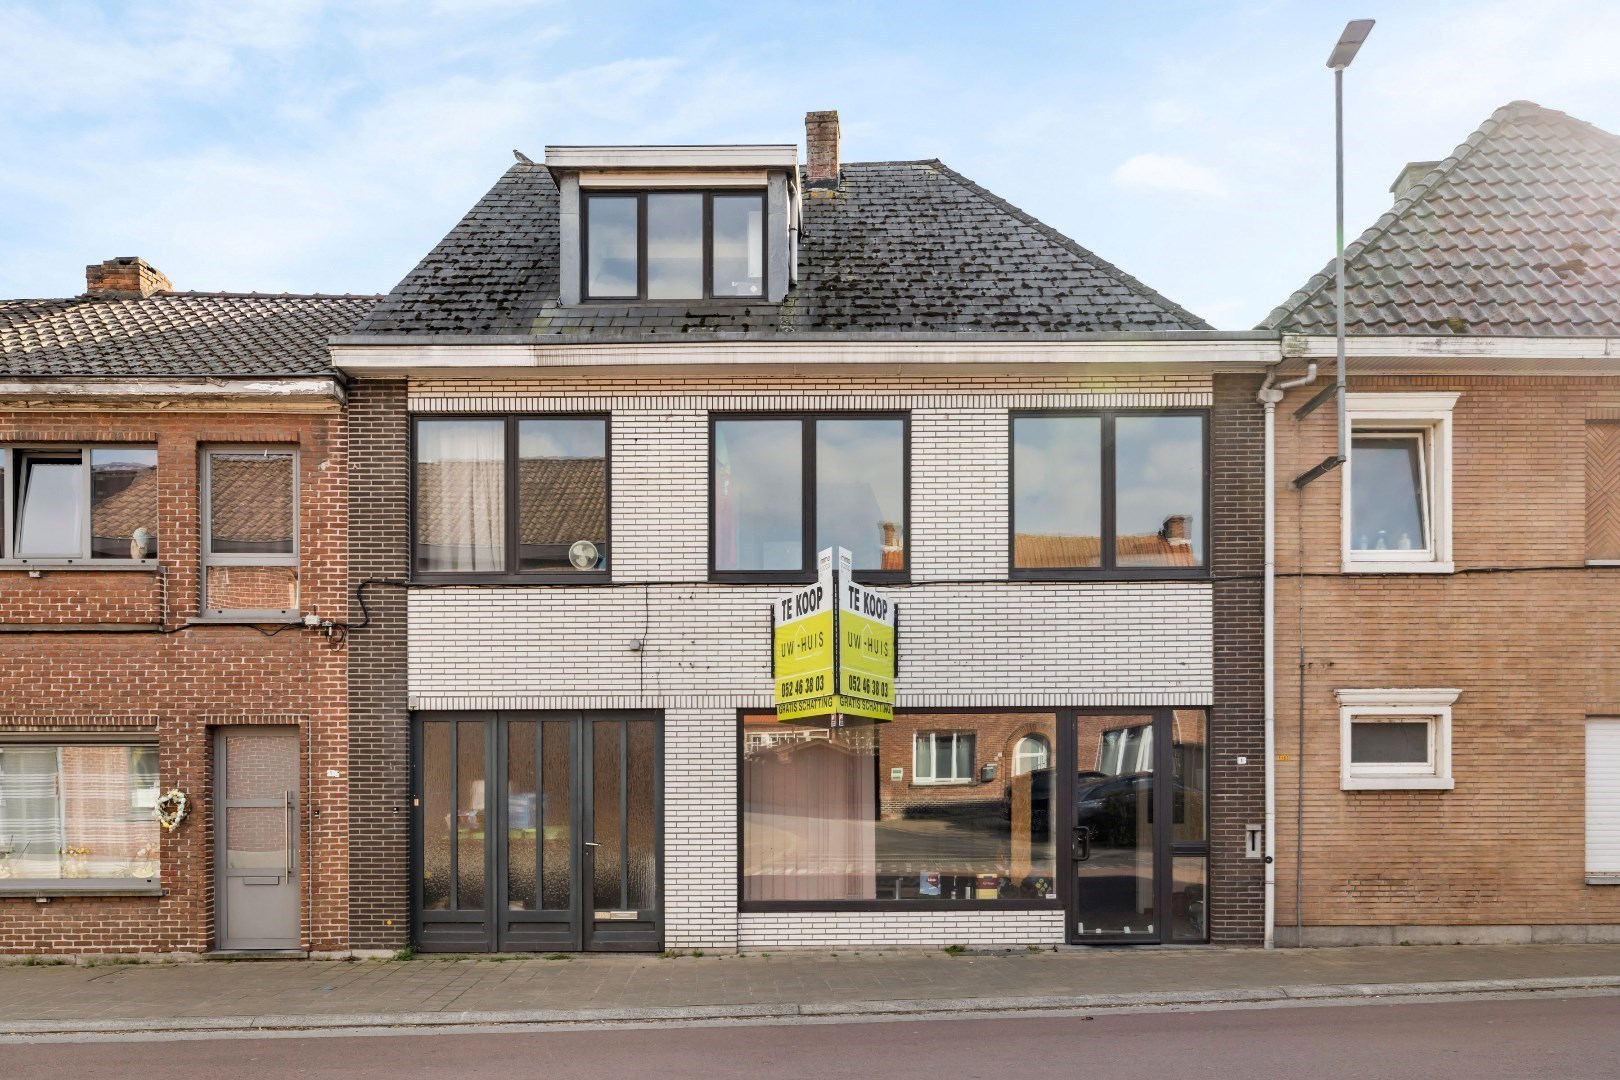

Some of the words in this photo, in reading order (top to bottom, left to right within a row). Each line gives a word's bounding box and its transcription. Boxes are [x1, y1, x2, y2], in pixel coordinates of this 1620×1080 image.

[781, 598, 792, 621] TE
[795, 586, 823, 617] KOOP
[848, 585, 860, 611] TE
[863, 591, 888, 620] KOOP
[781, 682, 793, 697] 052
[795, 679, 803, 695] 46
[805, 677, 814, 693] 38
[815, 675, 824, 692] 03
[848, 675, 860, 692] 052
[862, 678, 870, 694] 46
[872, 680, 879, 696] 38
[881, 682, 889, 697] 03
[778, 703, 797, 714] GRATIS
[798, 697, 833, 711] SCHATTING
[839, 696, 860, 709] GRATIS
[862, 699, 891, 714] SCHATTING
